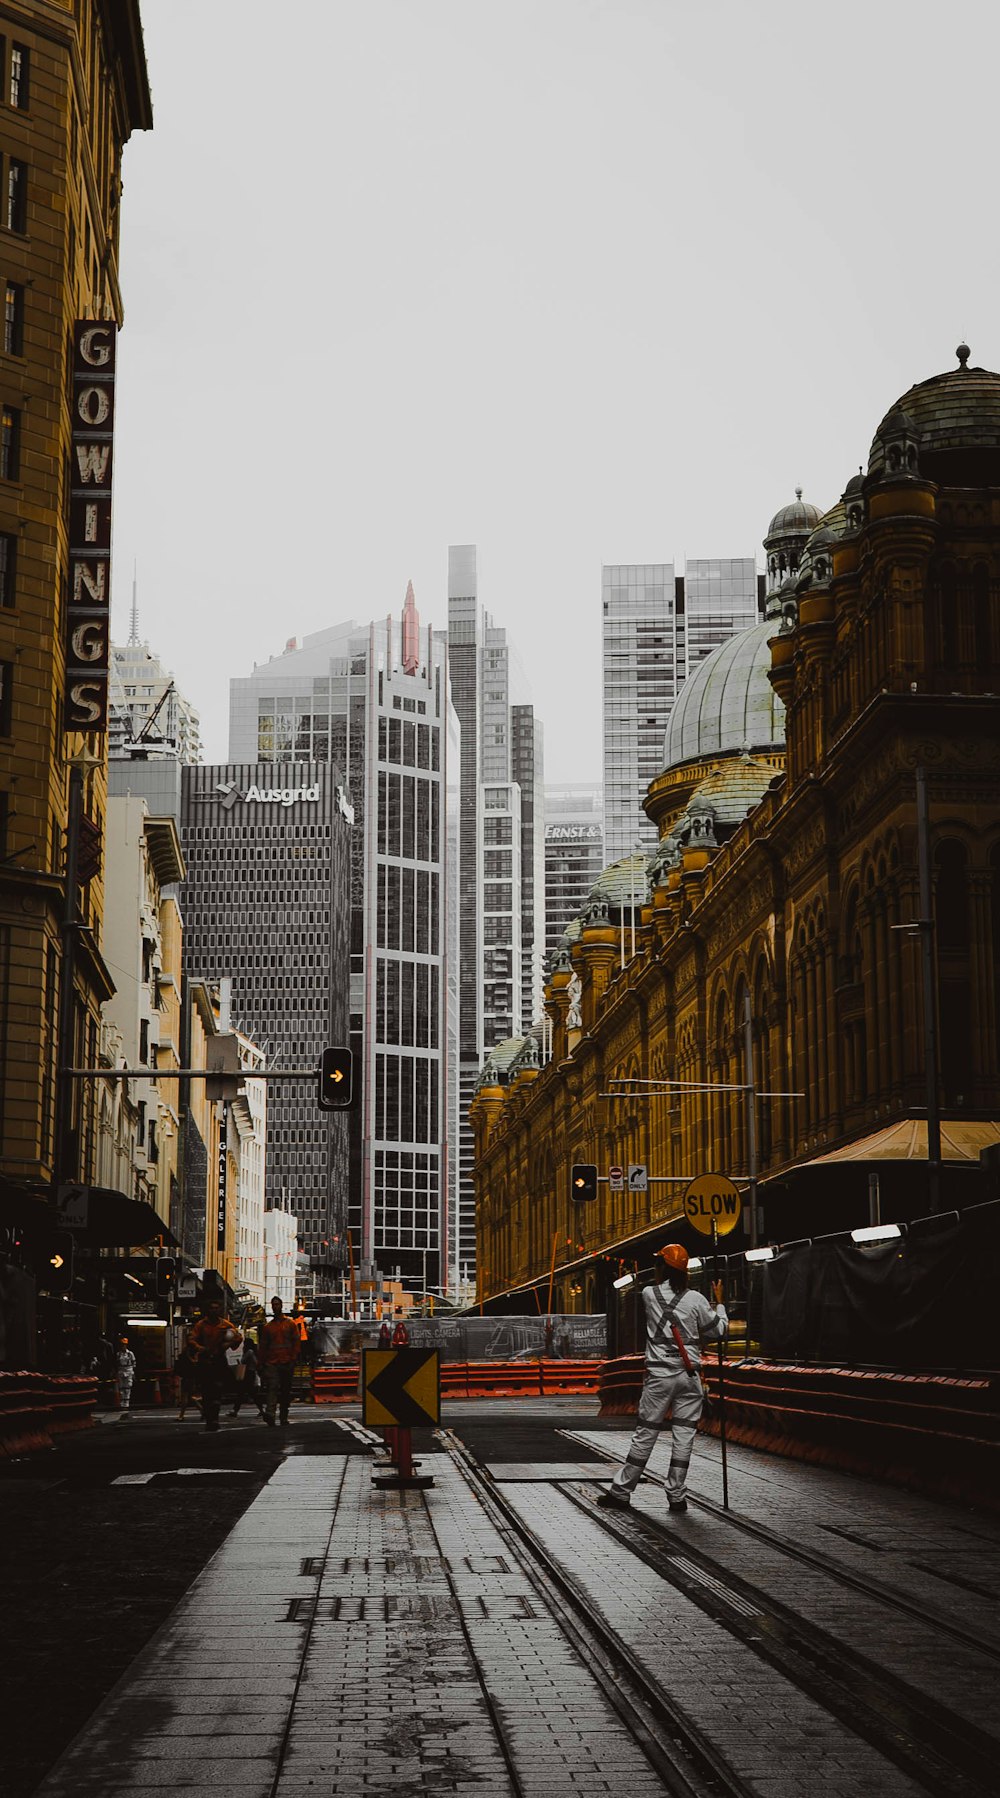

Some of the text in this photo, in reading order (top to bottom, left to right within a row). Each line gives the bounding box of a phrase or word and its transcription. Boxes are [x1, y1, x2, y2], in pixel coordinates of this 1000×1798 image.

[70, 327, 111, 724] GOWINGS
[245, 783, 320, 807] Ausgrid
[545, 824, 586, 839] ERNST
[218, 1142, 227, 1231] GALERIES
[687, 1193, 737, 1215] SLOW
[58, 1215, 86, 1225] ONLY
